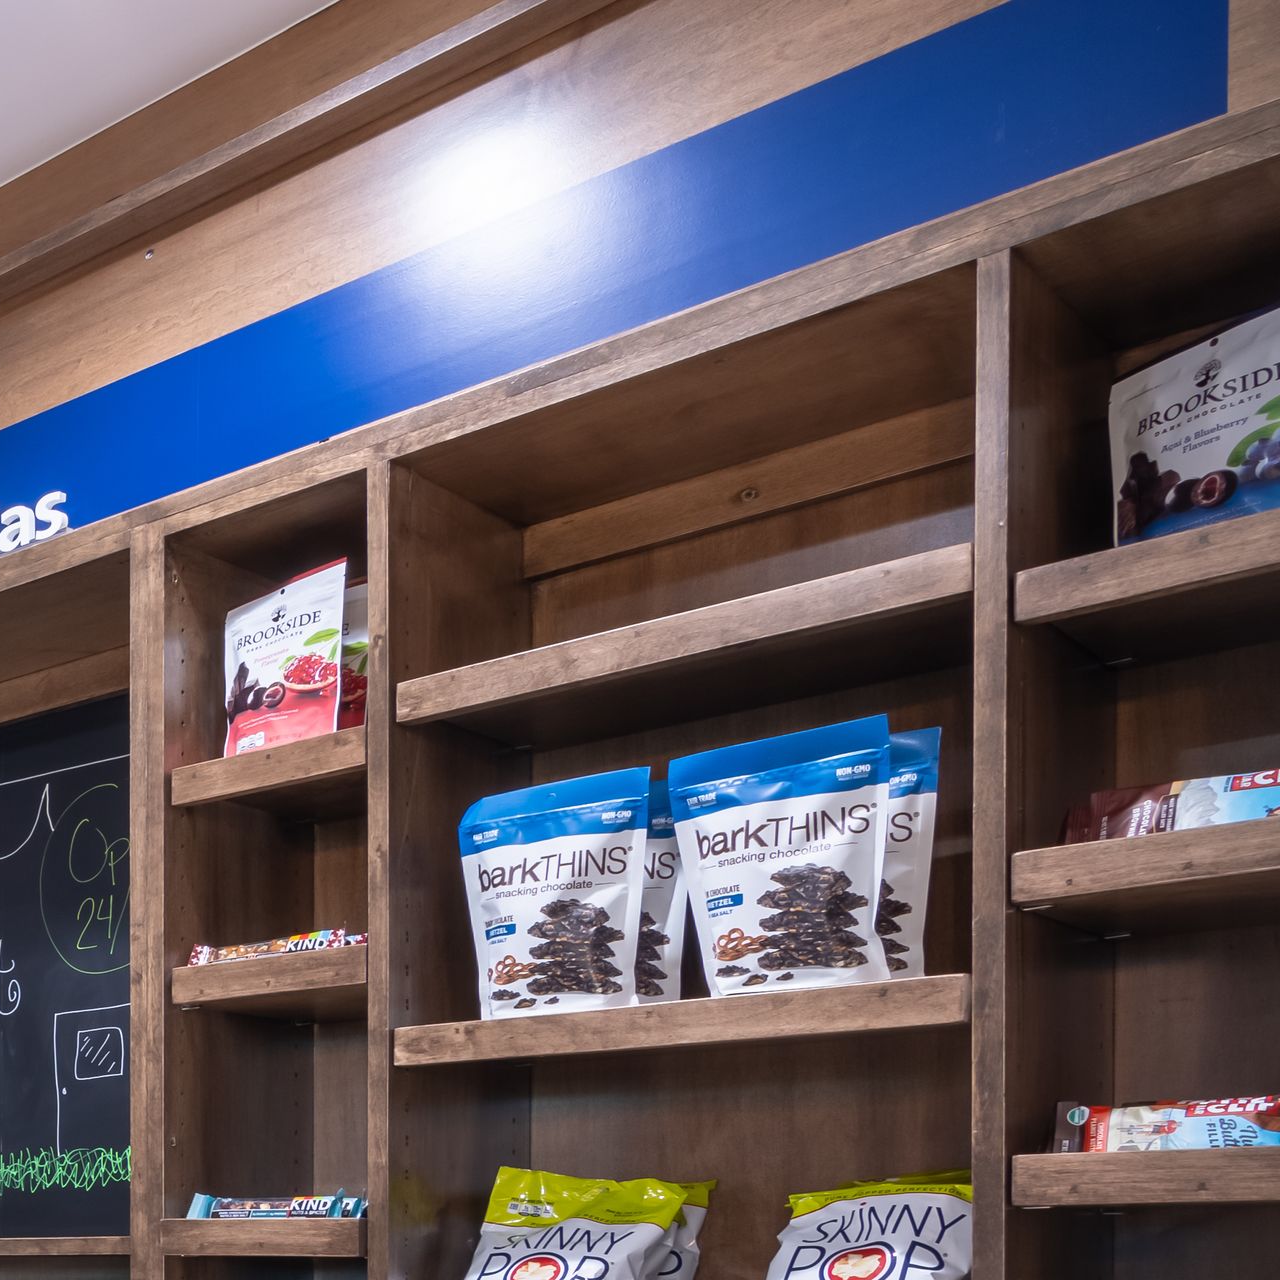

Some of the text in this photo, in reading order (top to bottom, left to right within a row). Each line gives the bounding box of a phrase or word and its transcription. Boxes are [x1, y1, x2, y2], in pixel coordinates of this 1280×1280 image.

[1154, 393, 1262, 437] DARK CHOCOLATE
[1184, 417, 1249, 444] & Blueberry
[1182, 435, 1221, 454] Flavors
[237, 610, 321, 651] BROOKSIDE
[836, 764, 871, 777] NON-GMO
[698, 792, 717, 804] TRADE
[601, 811, 631, 820] NON-GMO
[696, 805, 870, 861] barkTHINS
[718, 843, 831, 868] snacking chocolate
[478, 847, 627, 892] barkTHINS
[495, 880, 593, 899] snacking chocolate
[286, 938, 327, 951] KIND
[290, 1199, 331, 1210] KIND
[802, 1202, 967, 1243] SKINNY
[494, 1226, 633, 1254] SKINNY
